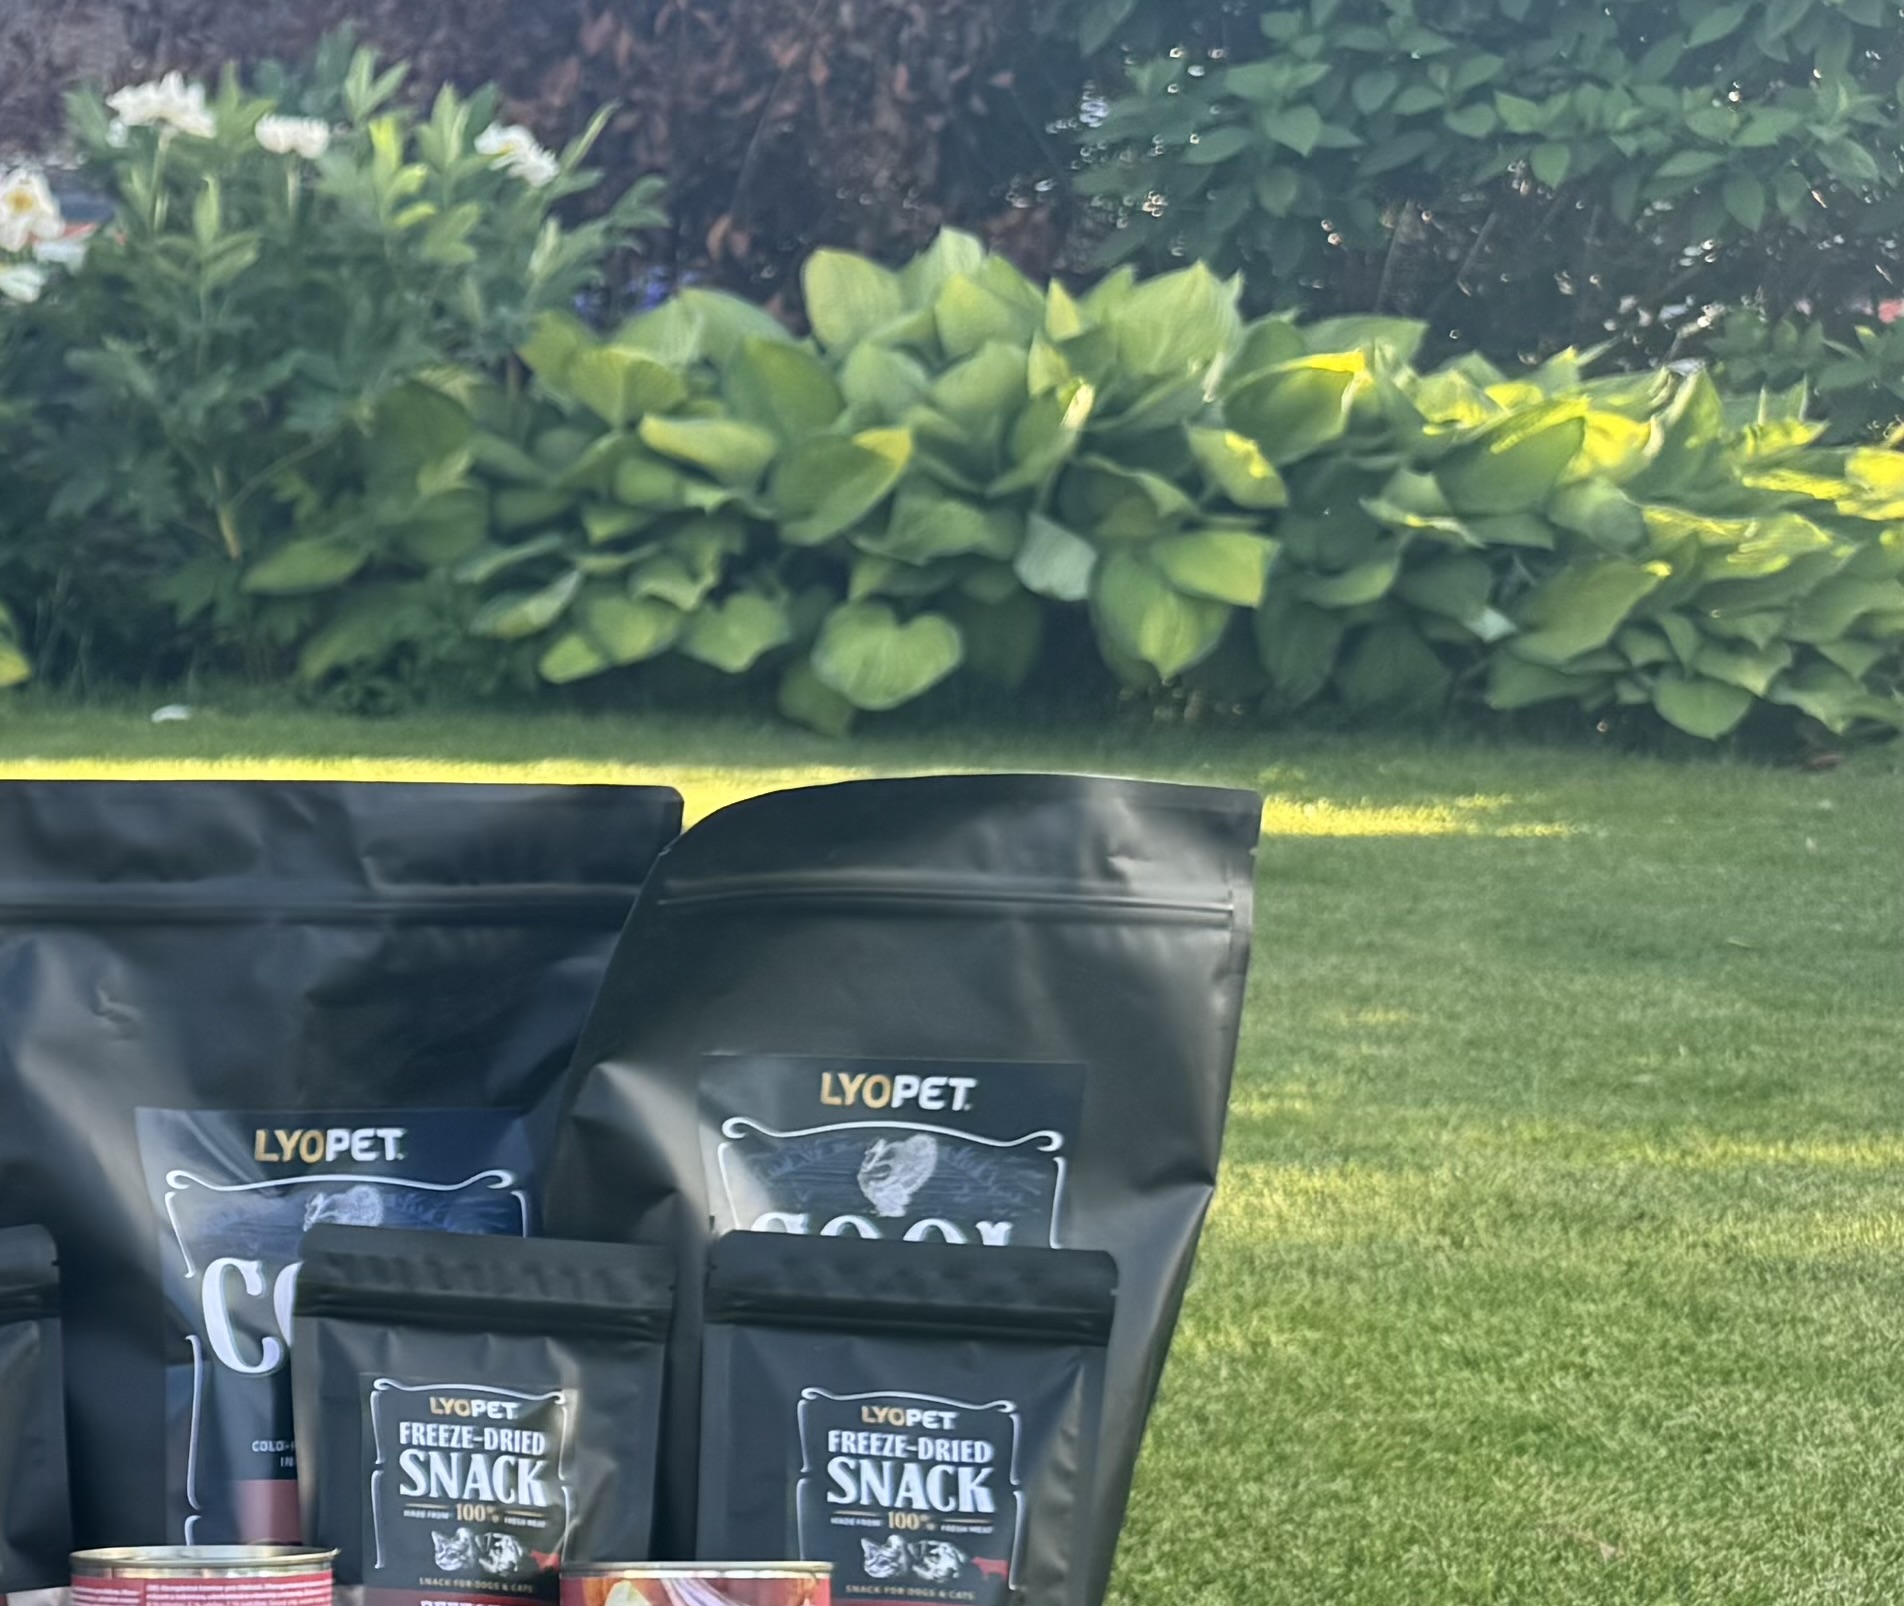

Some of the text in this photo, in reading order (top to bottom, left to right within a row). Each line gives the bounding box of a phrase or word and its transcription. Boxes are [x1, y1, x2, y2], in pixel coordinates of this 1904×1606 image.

[399, 1422, 546, 1455] FREEZE-DRIED
[828, 1430, 993, 1463] FREEZE-DRIED
[399, 1448, 548, 1507] SNACK
[827, 1456, 996, 1513] SNACK
